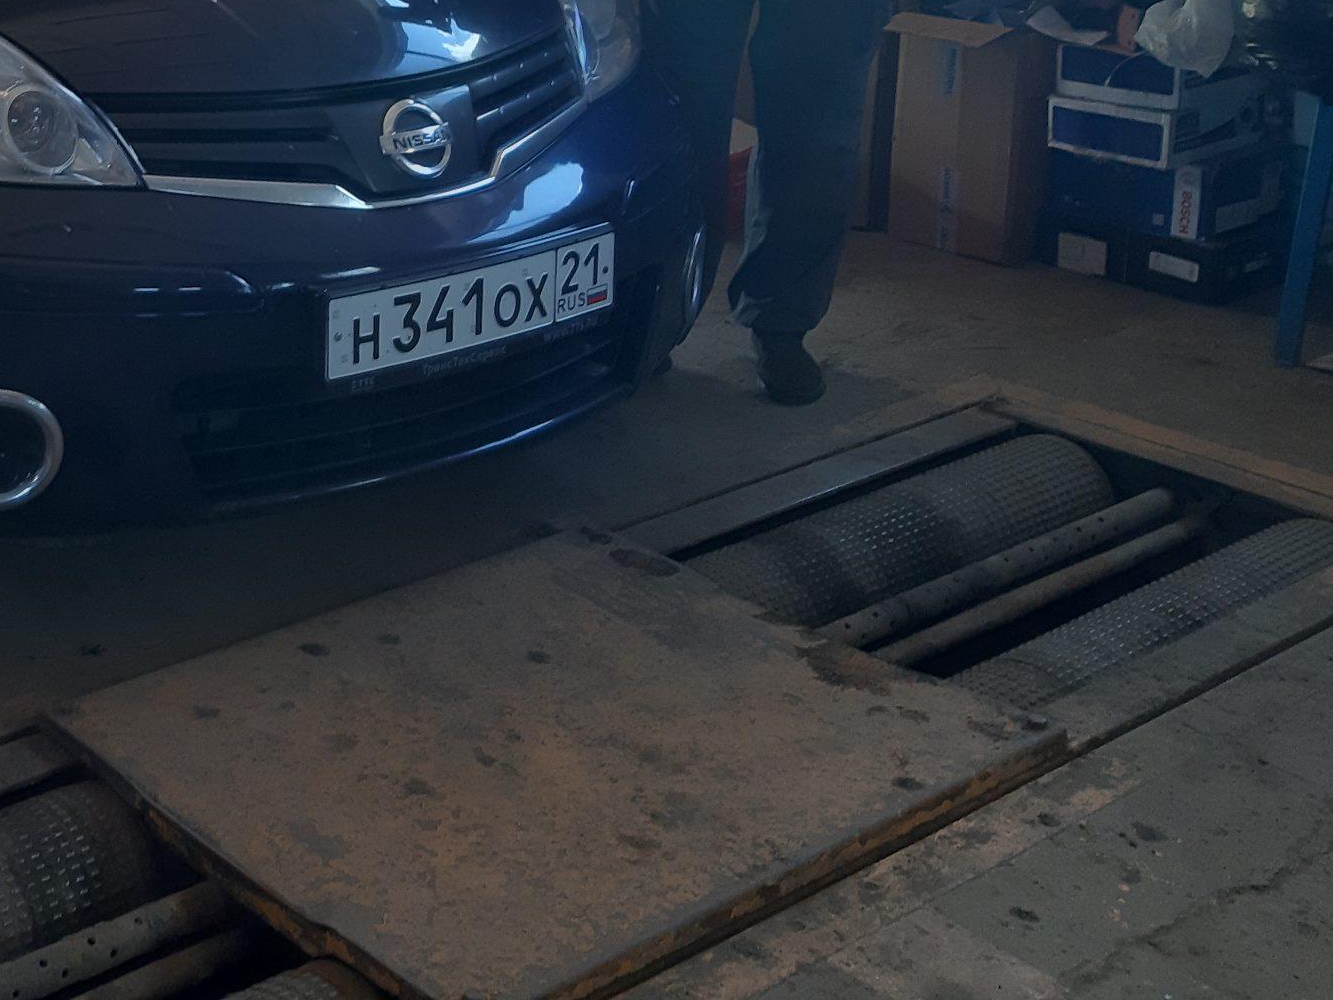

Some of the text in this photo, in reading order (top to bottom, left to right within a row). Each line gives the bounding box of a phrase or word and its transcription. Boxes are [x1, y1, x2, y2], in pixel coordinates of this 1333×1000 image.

[1179, 190, 1193, 234] BOSCH
[352, 242, 600, 364] Н341ОХ 21
[557, 291, 586, 315] RUS
